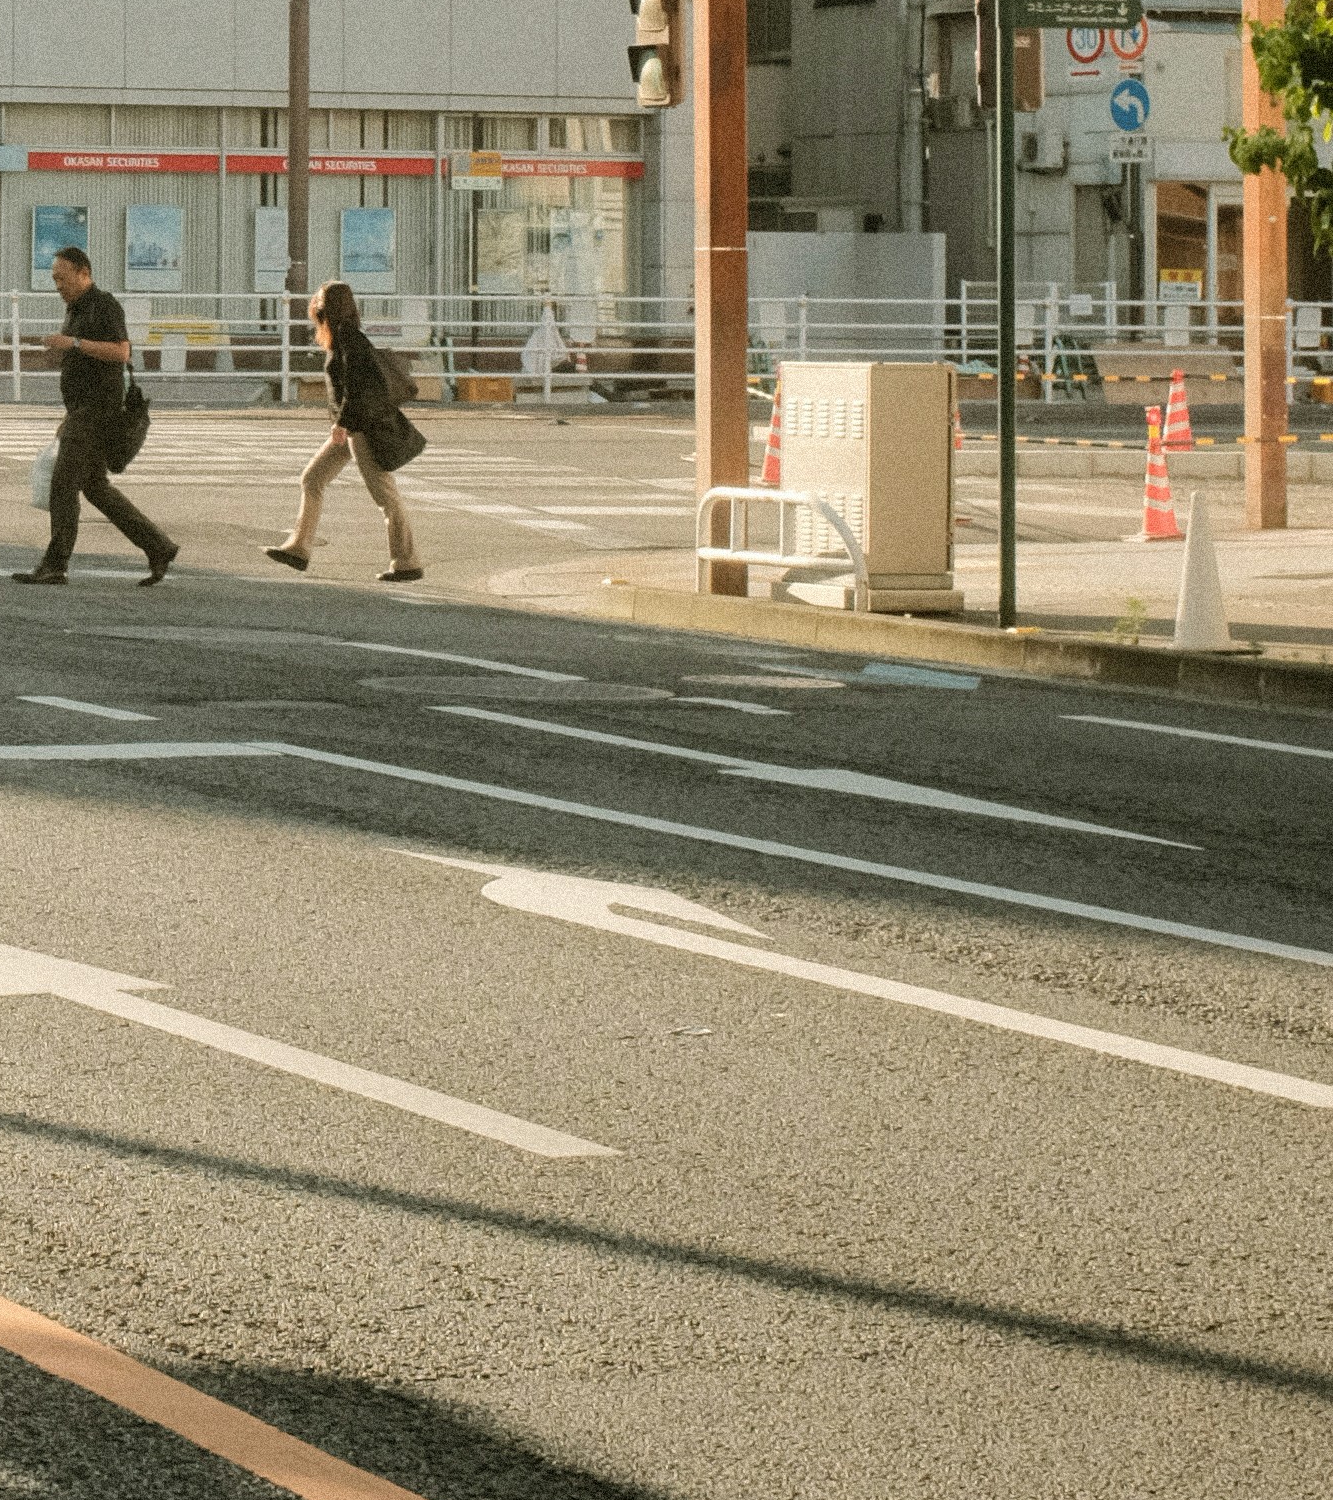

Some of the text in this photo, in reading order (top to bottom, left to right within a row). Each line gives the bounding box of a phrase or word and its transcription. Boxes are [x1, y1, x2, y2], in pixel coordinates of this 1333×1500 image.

[1075, 27, 1098, 50] 30
[63, 156, 160, 168] OKASAN SECURITIES
[324, 160, 377, 171] SECURITIES
